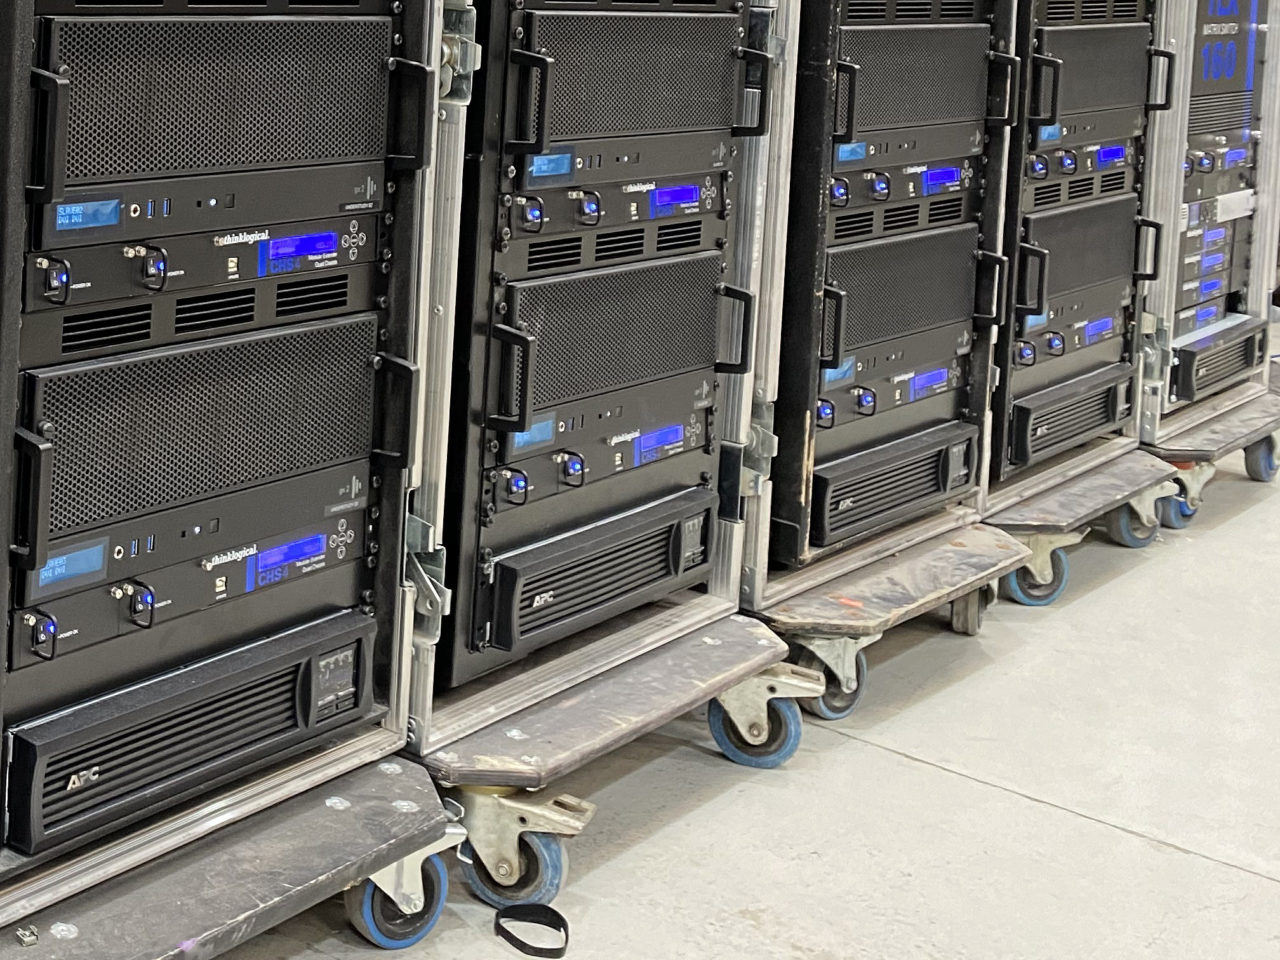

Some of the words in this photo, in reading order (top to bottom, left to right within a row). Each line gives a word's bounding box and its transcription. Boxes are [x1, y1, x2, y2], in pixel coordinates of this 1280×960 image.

[1202, 41, 1237, 81] 160
[533, 590, 554, 608] APC
[66, 766, 100, 791] APC
